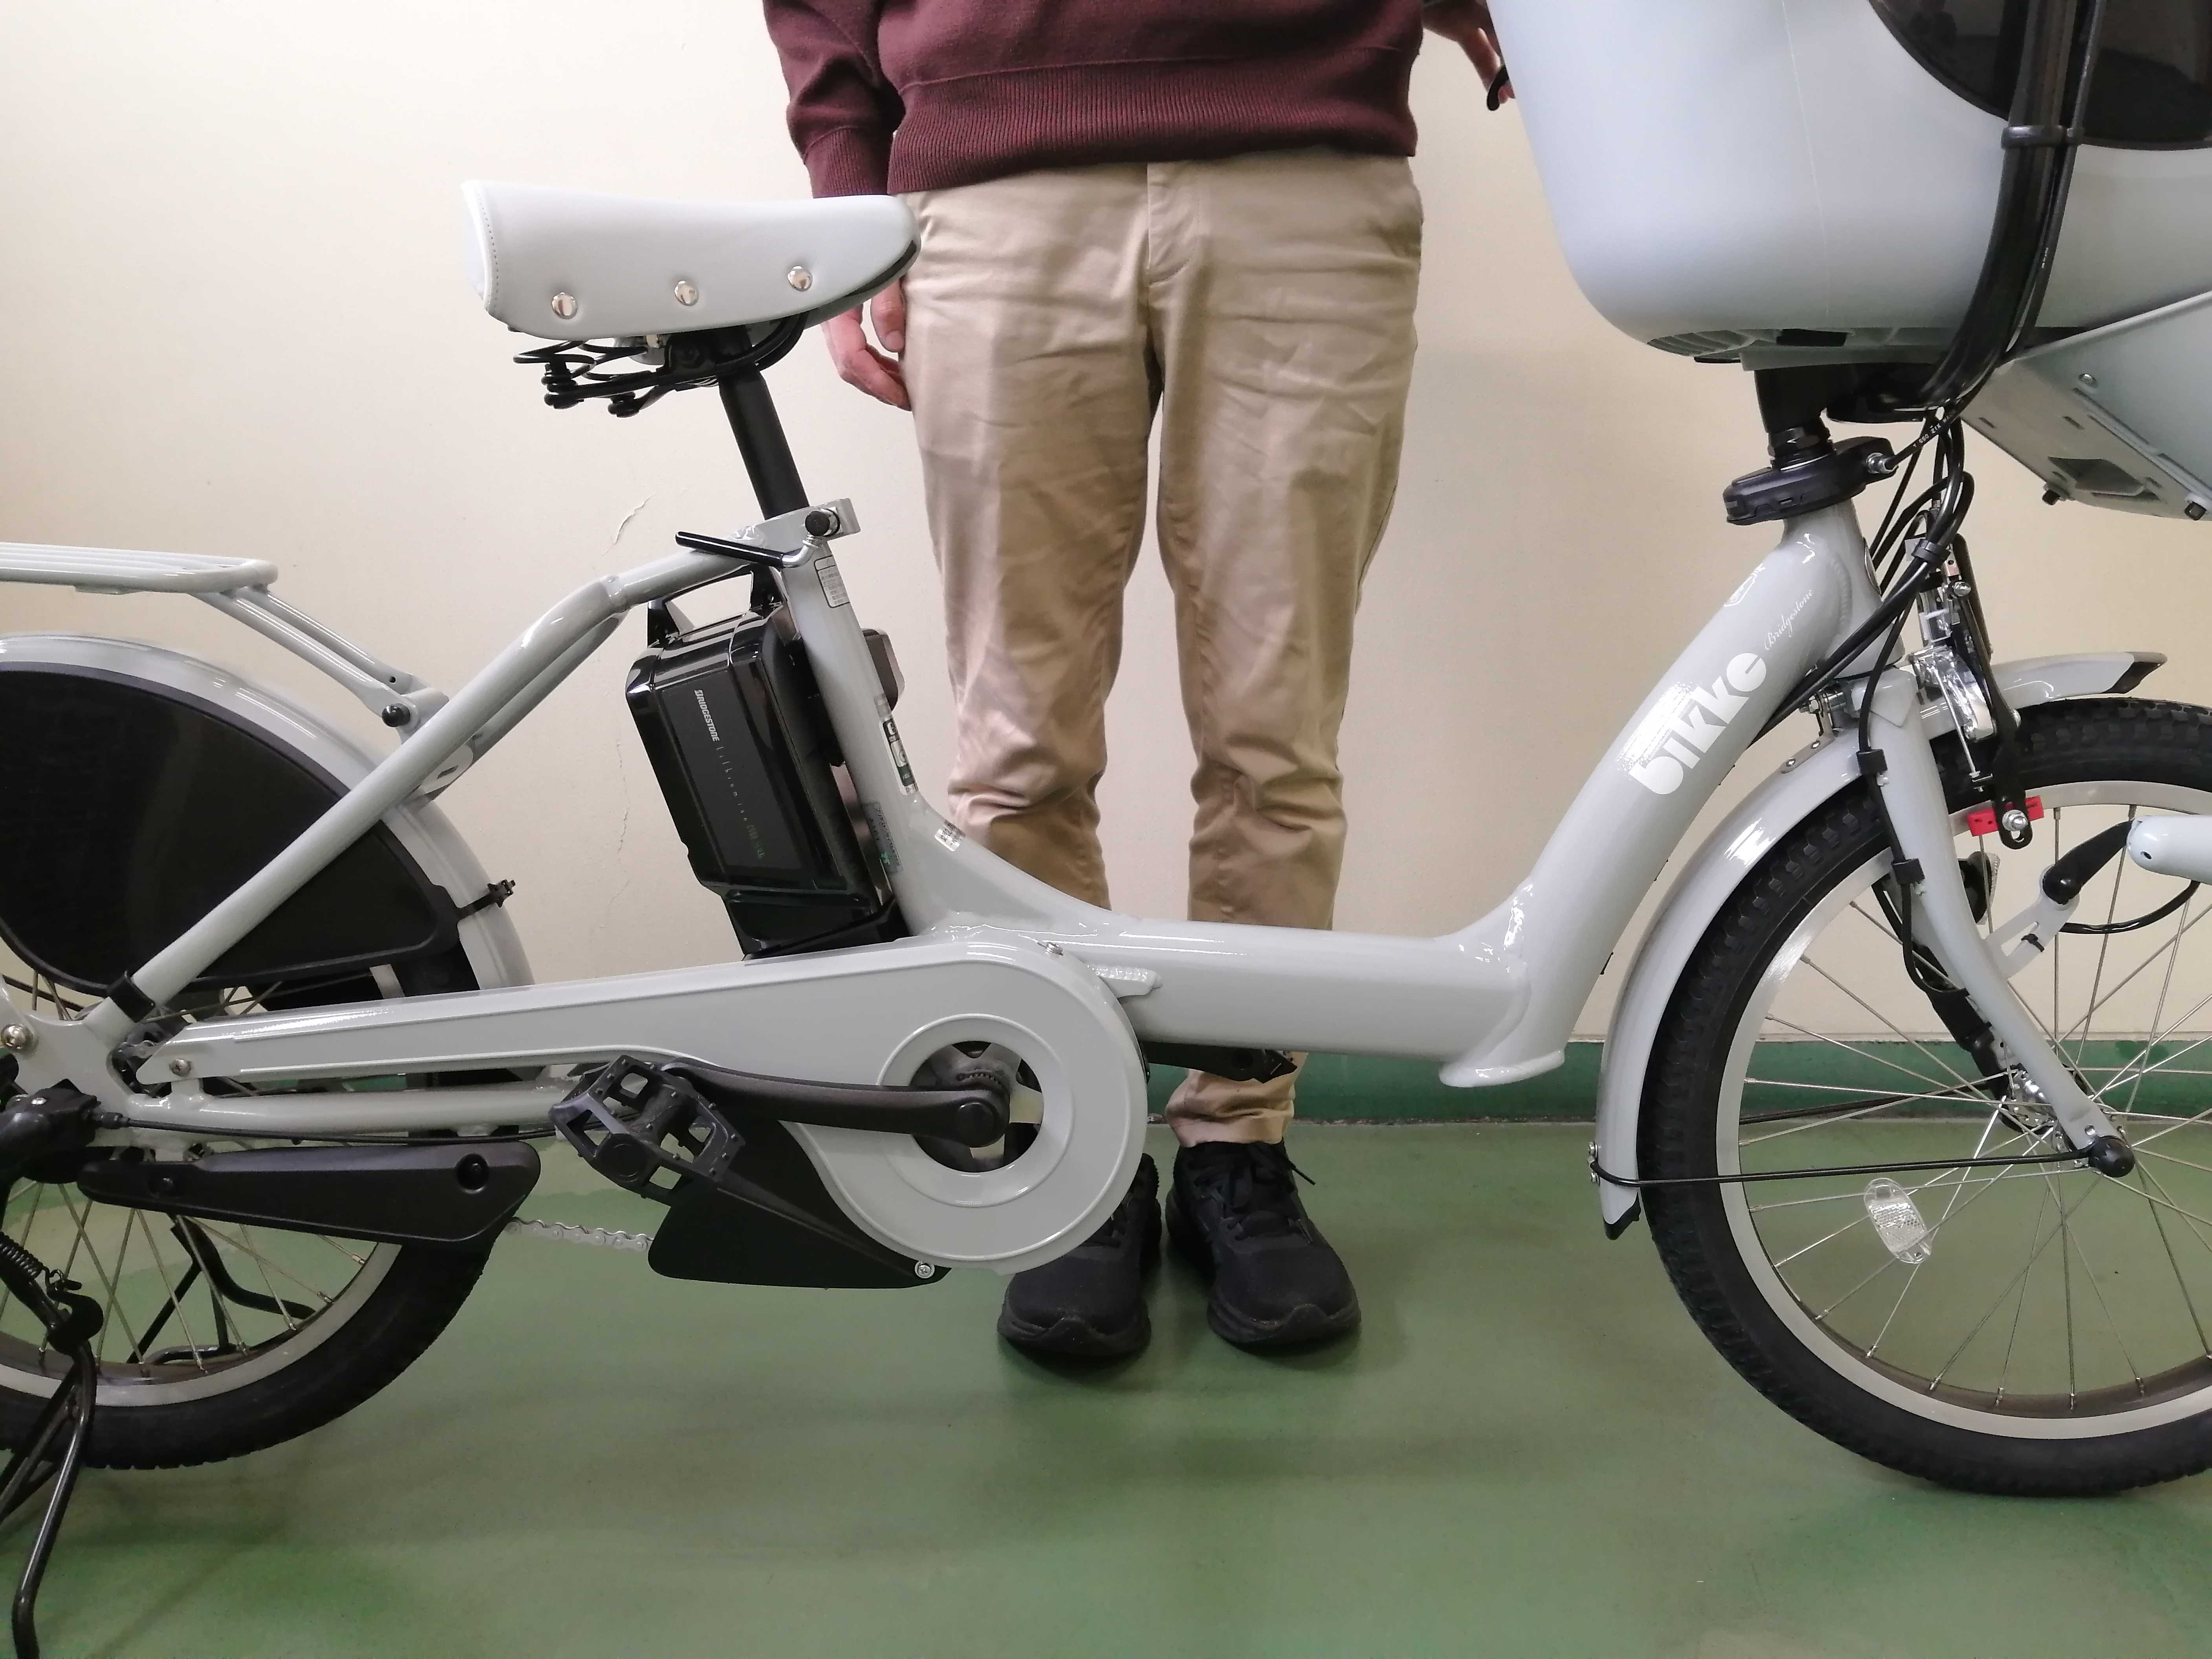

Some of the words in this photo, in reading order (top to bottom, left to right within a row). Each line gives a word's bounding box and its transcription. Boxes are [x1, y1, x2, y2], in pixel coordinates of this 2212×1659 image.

[1764, 589, 1813, 650] Bridgestone
[694, 690, 720, 742] BRIDGESTONE
[1628, 652, 1767, 795] bikke
